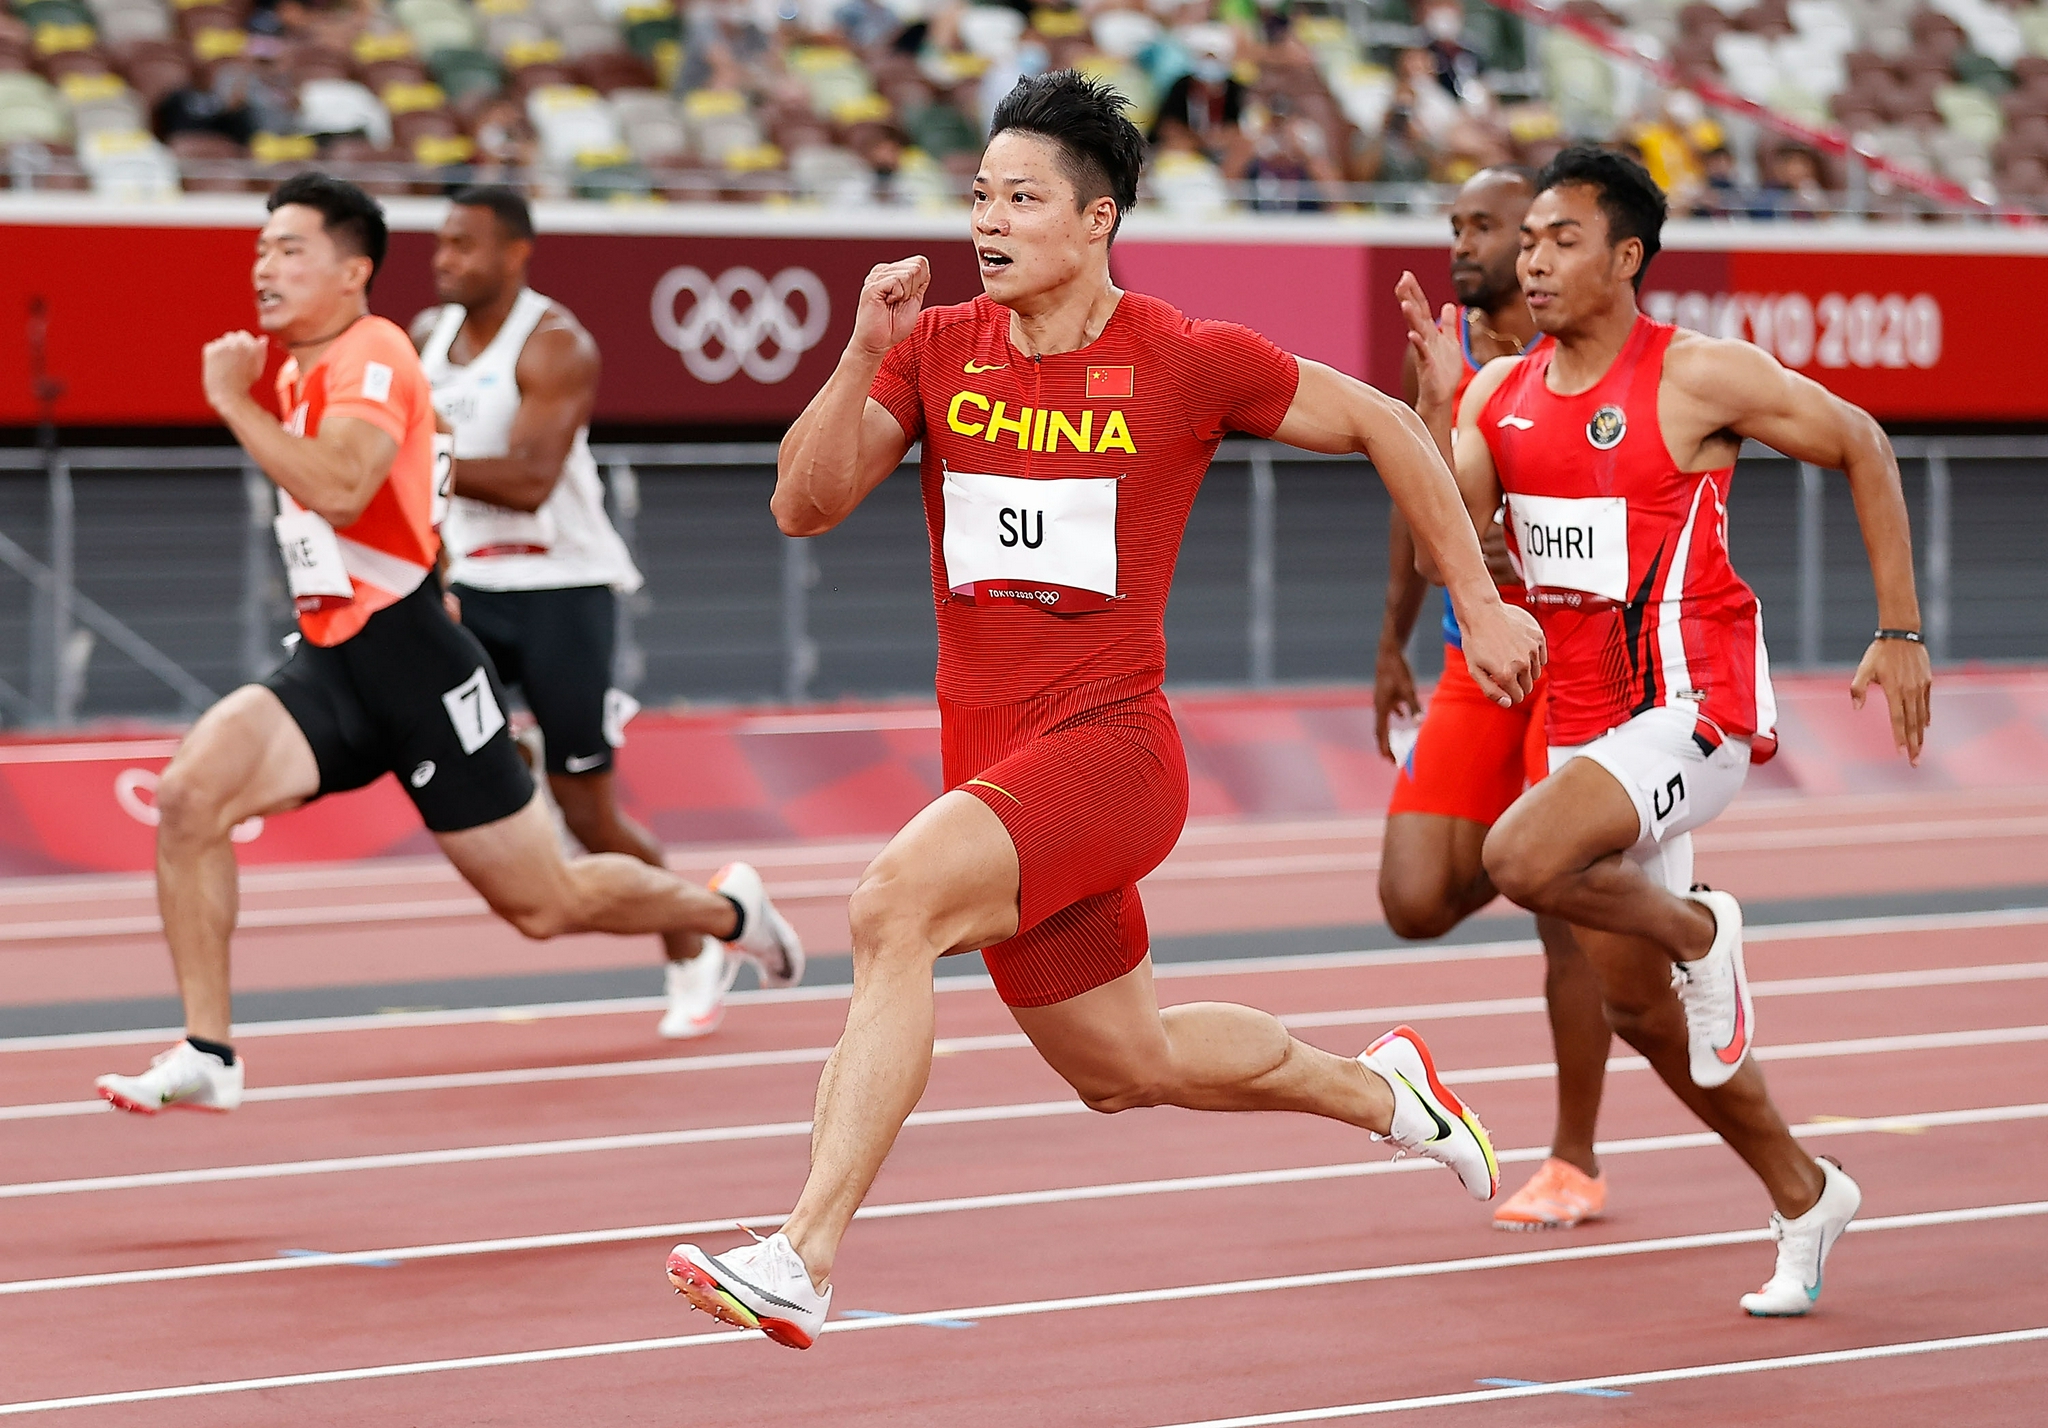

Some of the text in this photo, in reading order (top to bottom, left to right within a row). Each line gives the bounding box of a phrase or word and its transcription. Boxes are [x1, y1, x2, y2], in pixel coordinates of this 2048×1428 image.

[1815, 291, 1943, 369] 2020
[946, 390, 1138, 454] CHINA
[998, 506, 1044, 550] SU
[988, 589, 1034, 600] TOKYO 2020
[459, 682, 483, 736] 7
[1653, 771, 1685, 822] 5
